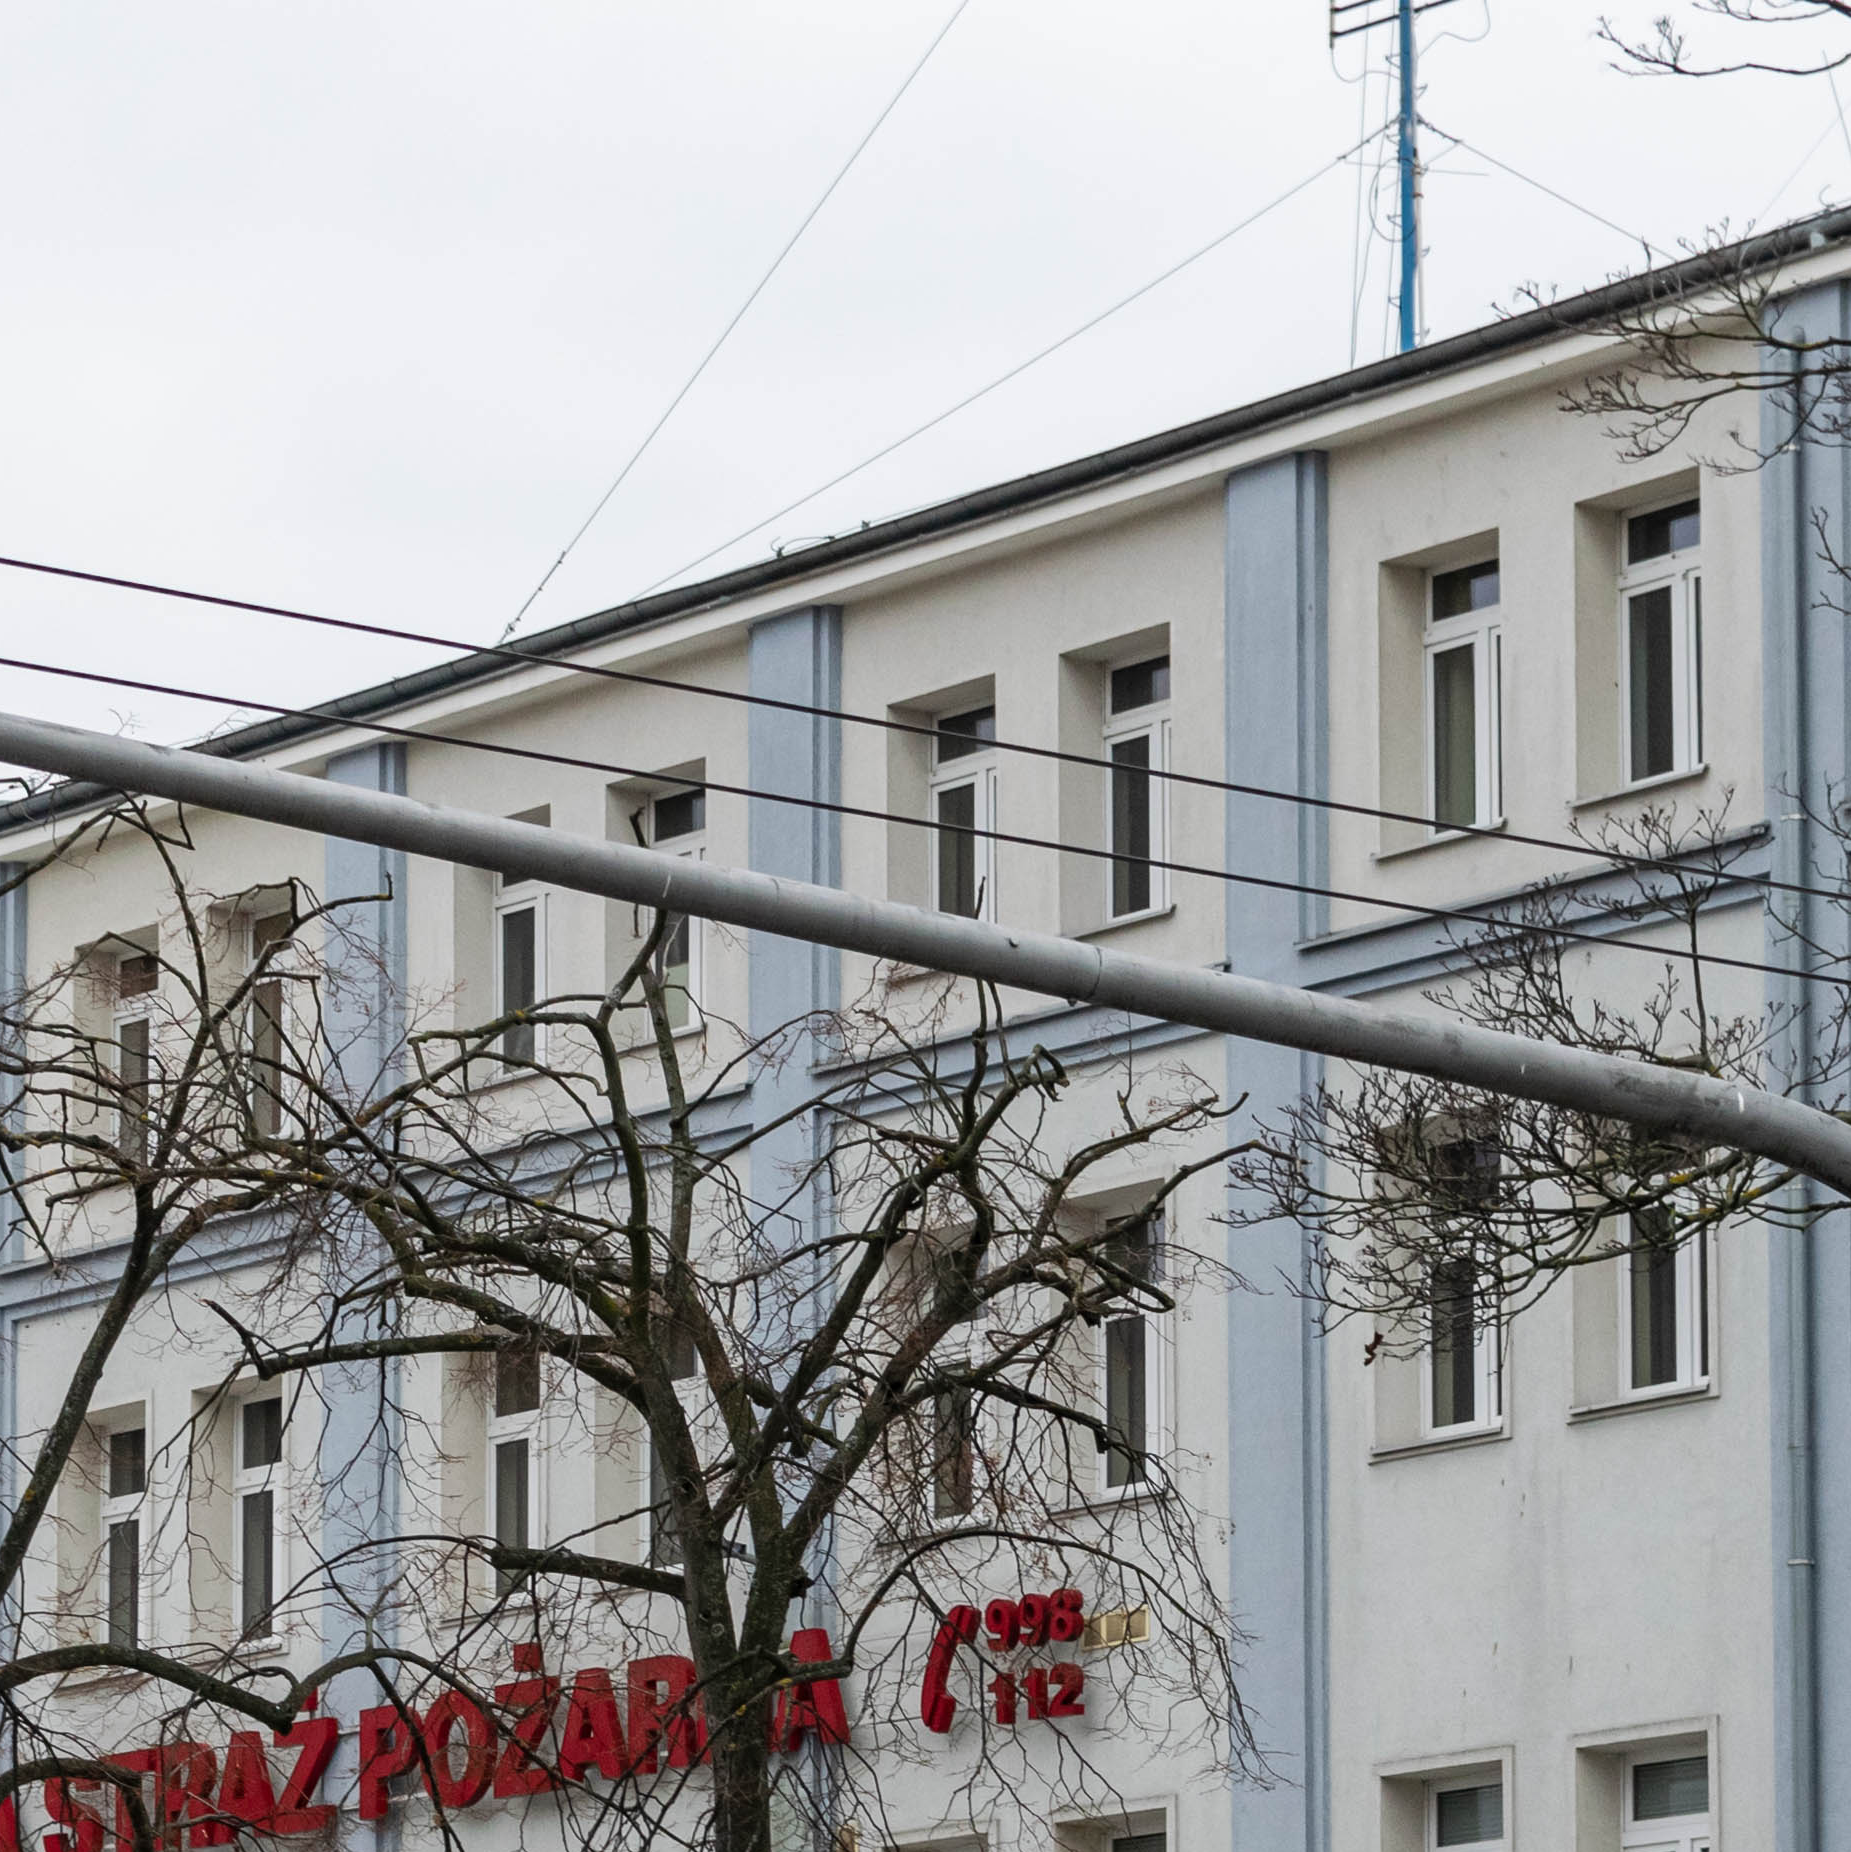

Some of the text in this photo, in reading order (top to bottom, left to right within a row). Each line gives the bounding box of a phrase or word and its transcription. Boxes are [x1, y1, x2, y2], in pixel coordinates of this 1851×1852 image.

[985, 1588, 1085, 1651] 998
[359, 1628, 850, 1820] POŻARA
[987, 1662, 1085, 1724] 112
